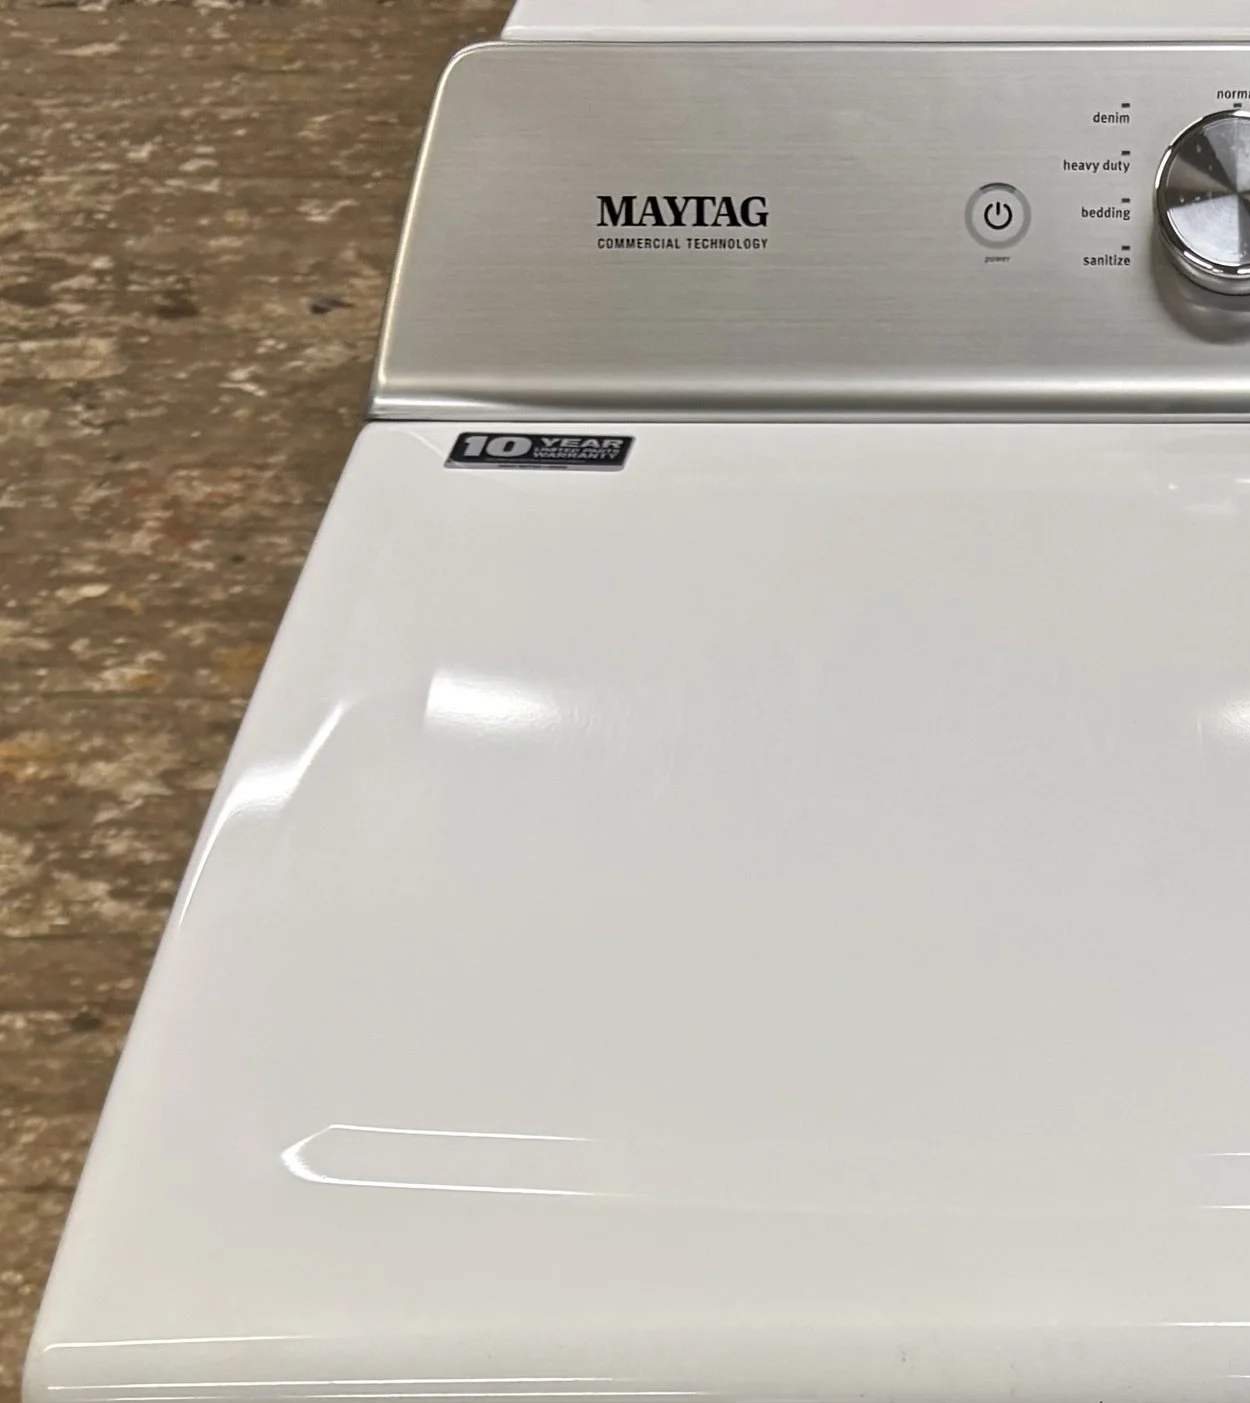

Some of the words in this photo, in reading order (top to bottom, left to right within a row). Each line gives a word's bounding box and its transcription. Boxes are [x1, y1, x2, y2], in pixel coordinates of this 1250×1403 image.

[1093, 112, 1129, 123] denim
[1064, 160, 1099, 173] heavy
[1103, 160, 1130, 173] duty
[597, 196, 768, 227] MAYTAG
[1082, 207, 1130, 220] bedding
[598, 238, 680, 249] COMMERCIAL
[687, 238, 767, 249] TECHNOLOGY
[1084, 255, 1130, 266] sanitize
[463, 435, 532, 457] 10
[541, 438, 624, 448] YEAR
